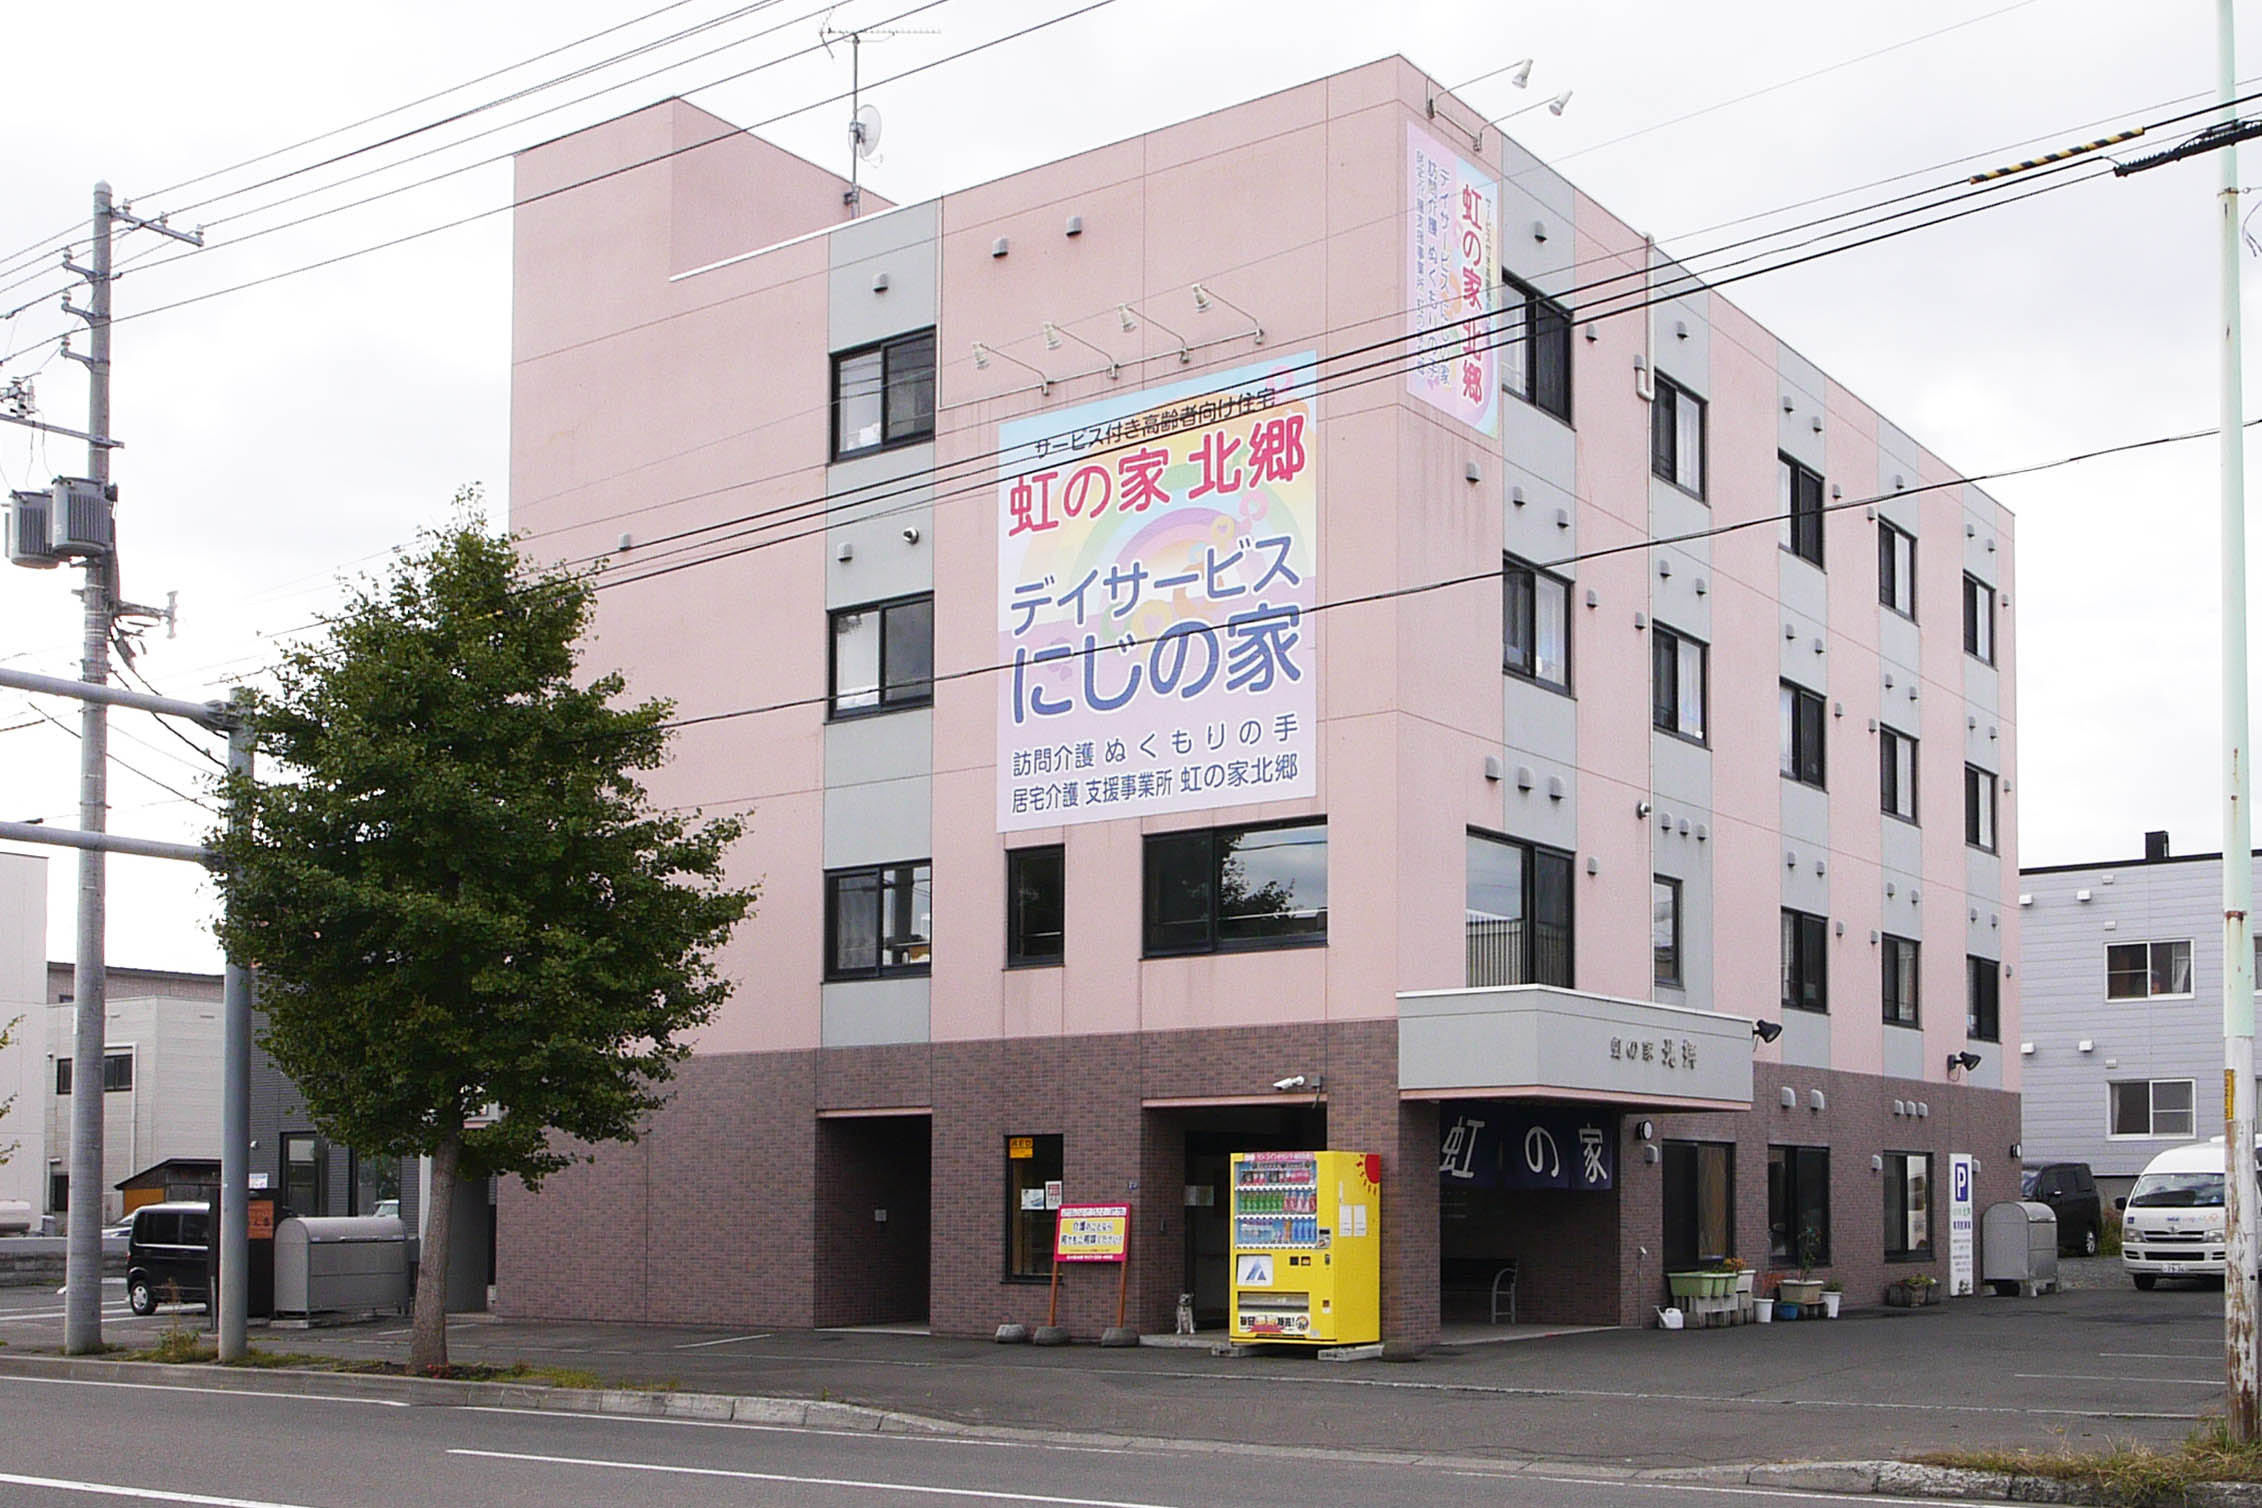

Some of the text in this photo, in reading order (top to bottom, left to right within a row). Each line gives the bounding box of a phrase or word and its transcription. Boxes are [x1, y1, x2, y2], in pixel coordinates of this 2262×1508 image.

[1462, 184, 1482, 310] 虹の家
[1034, 387, 1276, 459] サービス付き高齢者向け住宅
[1009, 415, 1306, 537] 虹の家 北郷
[1011, 535, 1300, 636] デイサービス
[1014, 603, 1301, 723] にじの家
[1012, 753, 1298, 814] 居宅介護 支援事業所 虹の家北郷
[1013, 742, 1095, 777] 訪問介護
[1011, 1138, 1033, 1148] AED
[1440, 1116, 1608, 1183] 虹の家
[1957, 1166, 1966, 1198] P
